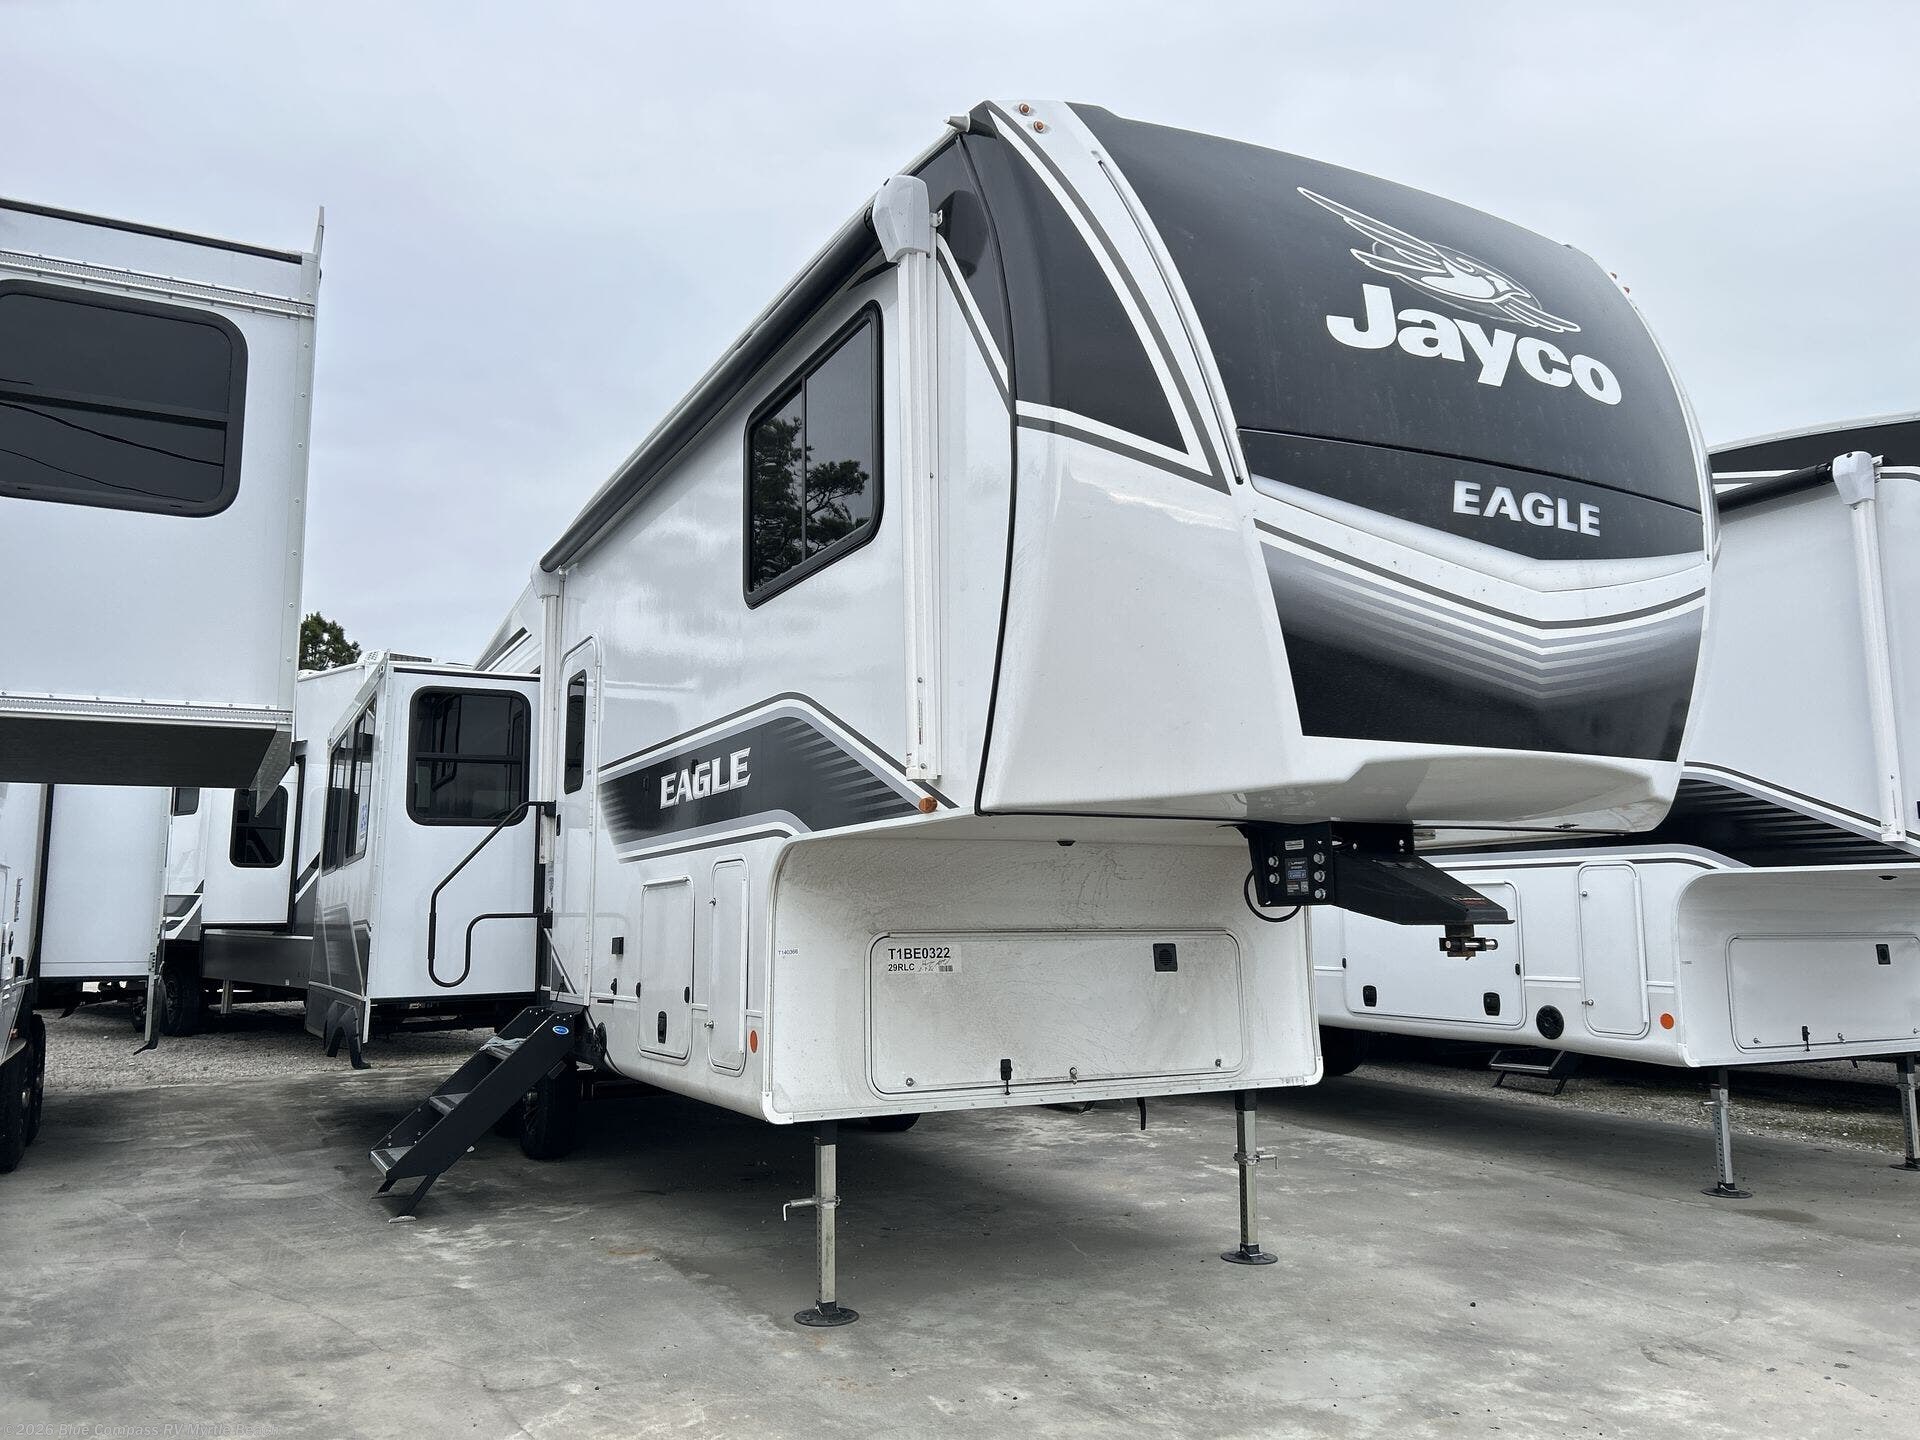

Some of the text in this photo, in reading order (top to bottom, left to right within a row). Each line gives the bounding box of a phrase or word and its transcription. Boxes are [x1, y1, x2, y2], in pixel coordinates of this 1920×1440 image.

[1326, 283, 1622, 405] Jayco
[1453, 480, 1600, 537] EAGLE
[660, 747, 751, 809] EAGLE
[887, 947, 951, 960] T1BE0322
[888, 963, 915, 972] 29RLC
